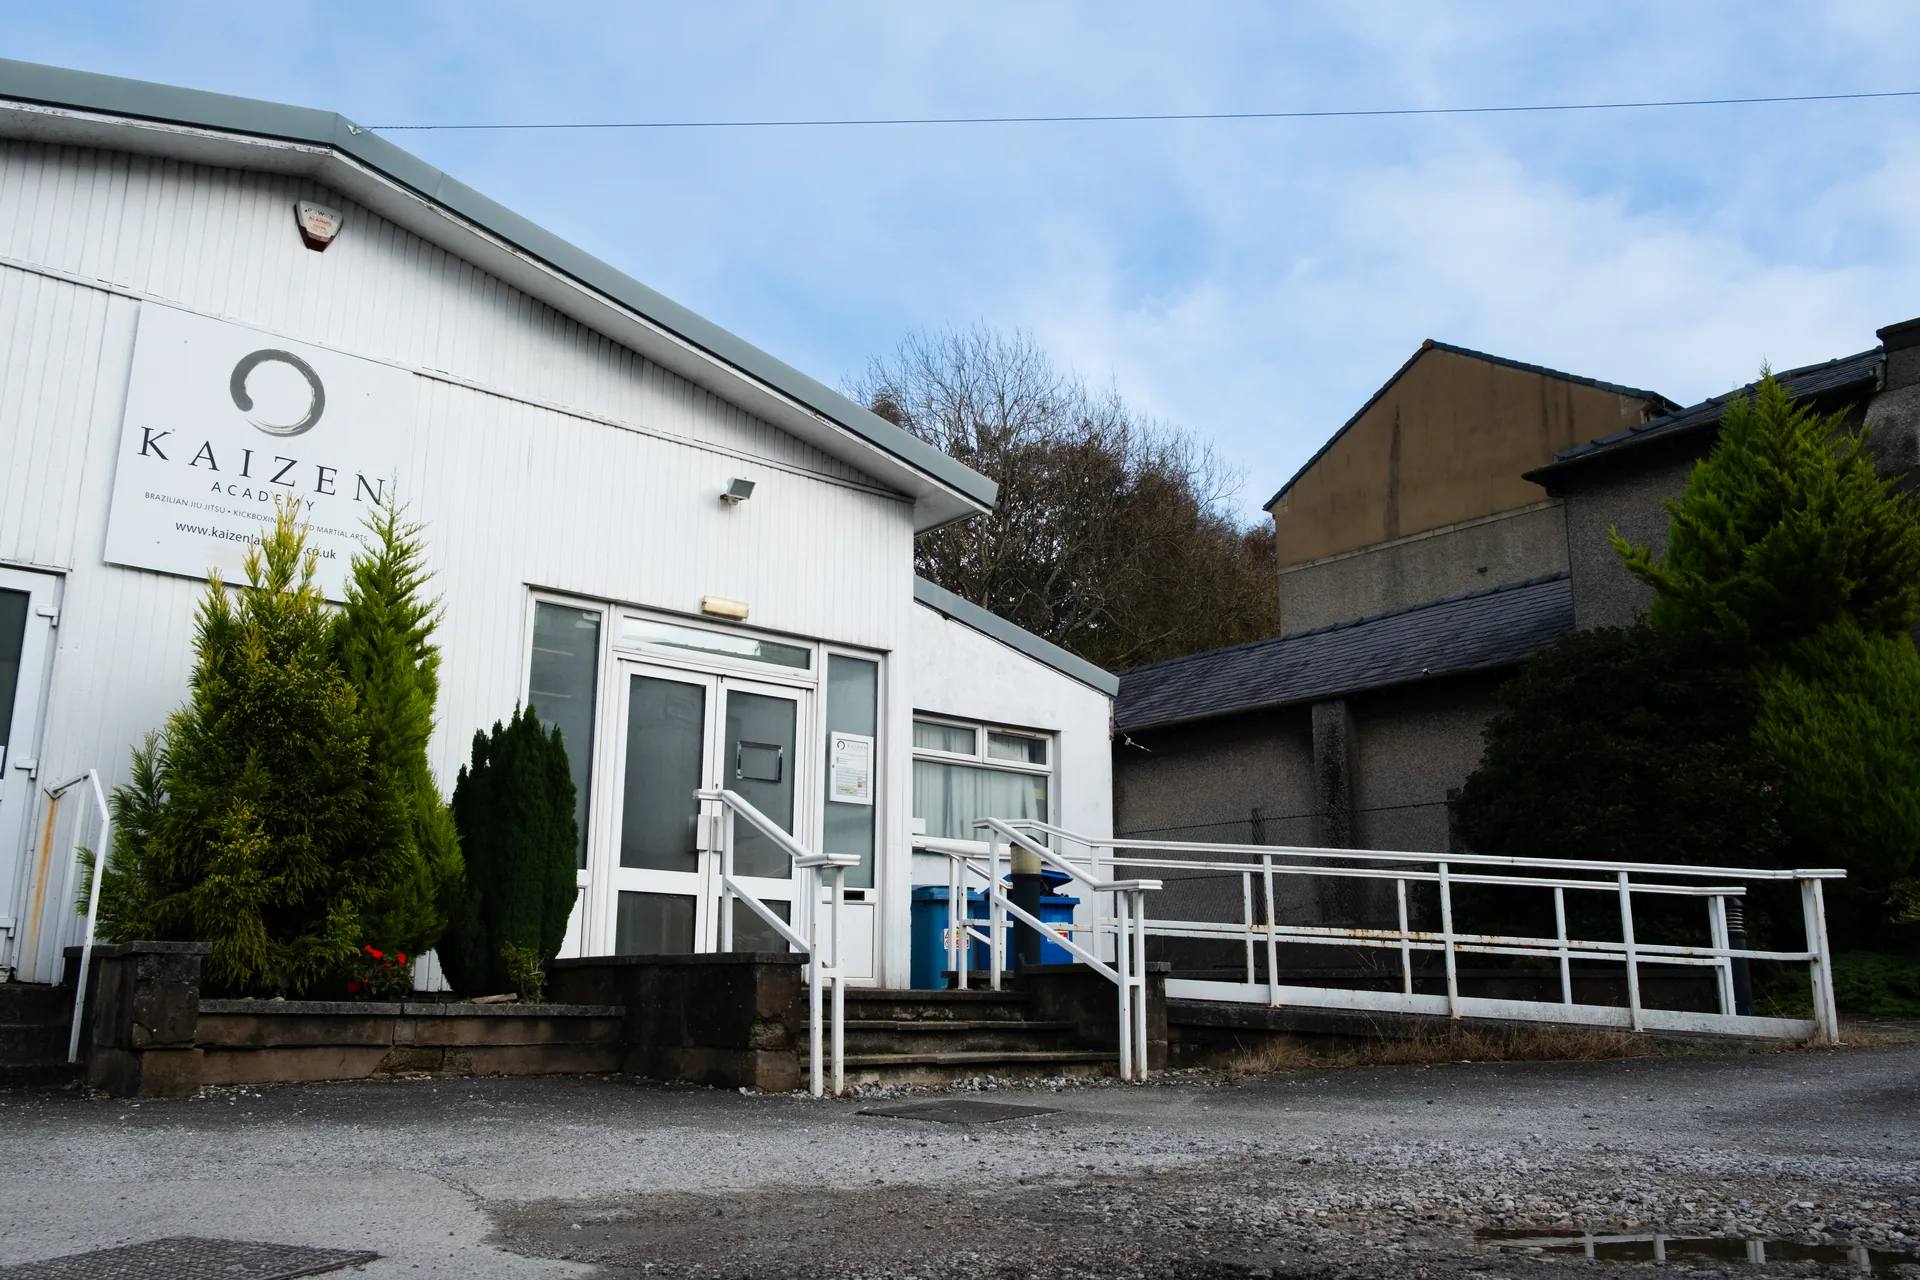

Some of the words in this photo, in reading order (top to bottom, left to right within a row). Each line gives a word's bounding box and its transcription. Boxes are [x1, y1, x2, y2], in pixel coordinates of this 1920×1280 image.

[137, 426, 386, 506] KAIZEN
[144, 491, 189, 507] BRAZILIAN
[190, 501, 203, 509] JIU
[204, 504, 226, 514] JITSU
[233, 509, 279, 525] KICKBOXIN
[292, 521, 315, 531] MIXD
[316, 526, 348, 539] MARTIAL
[349, 532, 368, 542] ARTS
